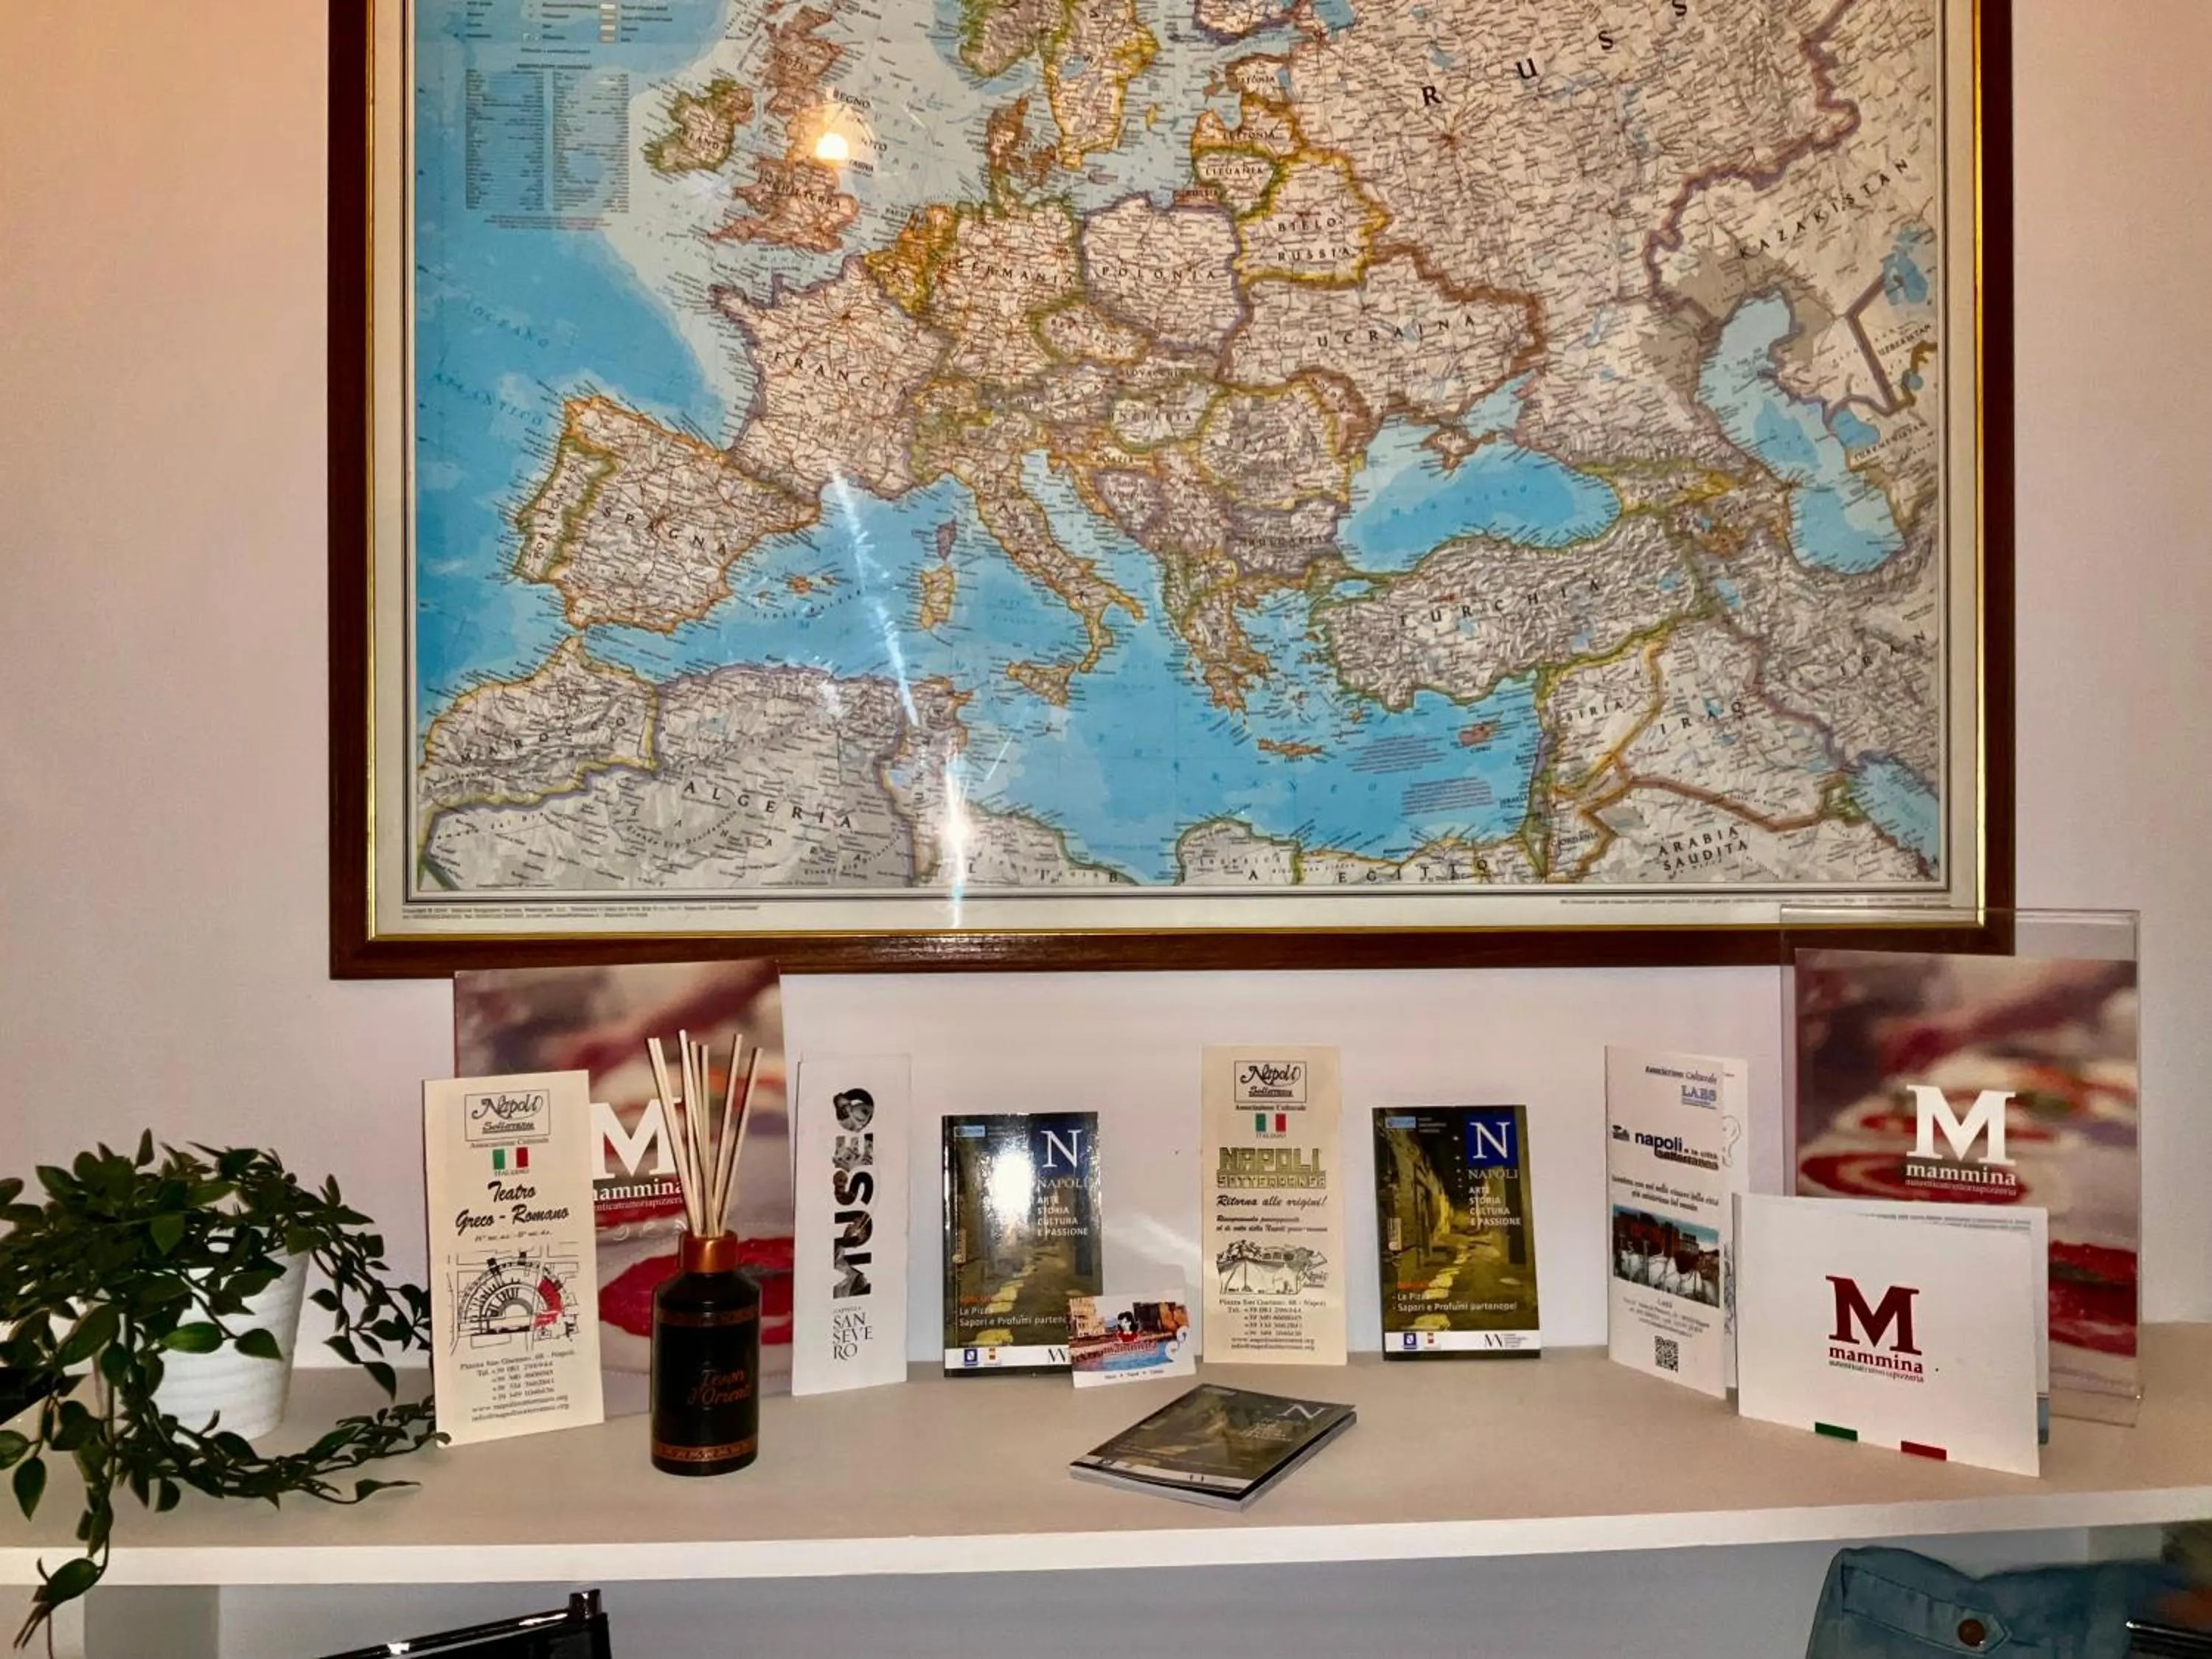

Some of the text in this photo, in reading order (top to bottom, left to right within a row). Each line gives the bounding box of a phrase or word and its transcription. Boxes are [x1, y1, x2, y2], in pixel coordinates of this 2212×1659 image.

[1205, 167, 1263, 175] LITUANIA
[1739, 159, 1909, 261] KAZAKISTAN
[1278, 247, 1353, 262] RUSSIA
[955, 258, 1074, 285] GERMANIA
[1102, 265, 1216, 281] POLONIA
[1317, 315, 1475, 348] UCRAINA
[774, 351, 909, 397] FRANCIA
[602, 506, 726, 556] SPAGNA
[1399, 578, 1600, 626] TURCHIA
[1566, 700, 1624, 721] SIRIA
[1660, 700, 1745, 736] IRAQ
[461, 717, 626, 764] MAROCCO
[684, 781, 852, 828] ALGERIA
[1659, 826, 1739, 858] ARABIA
[1663, 839, 1748, 872] SAUDITA
[1239, 1063, 1302, 1087] Napoli
[471, 1094, 543, 1119] Napoli
[1906, 1084, 2017, 1166] M
[590, 1098, 682, 1180] M
[1040, 1129, 1083, 1168] N
[1469, 1121, 1511, 1159] N
[1635, 1132, 1683, 1156] napoli
[1218, 1147, 1320, 1171] NAPOLI
[1468, 1169, 1519, 1180] NAPOLI
[1906, 1164, 2017, 1186] mammina
[487, 1180, 537, 1203] Teatro
[833, 1088, 875, 1299] MUSEO
[1262, 1195, 1283, 1206] alle
[1286, 1194, 1328, 1211] origini!
[1469, 1196, 1501, 1205] STORIA
[456, 1209, 495, 1236] Greco
[511, 1204, 569, 1225] Romano
[1037, 1206, 1070, 1215] STORIA
[1037, 1217, 1079, 1227] CULTURA
[1470, 1206, 1511, 1216] CULTURA
[1478, 1217, 1522, 1226] PASSIONE
[1046, 1228, 1089, 1237] PASSIONE
[1397, 1301, 1425, 1312] Sapori
[1434, 1301, 1468, 1311] Profumi
[1470, 1301, 1517, 1312] partenopei
[1825, 1275, 1922, 1356] M
[834, 1312, 866, 1329] SAN
[960, 1318, 987, 1328] Sapori
[998, 1315, 1032, 1326] Profumi
[1035, 1314, 1066, 1325] parten
[833, 1326, 873, 1343] SEVE
[834, 1342, 858, 1361] RO
[1829, 1346, 1923, 1374] mammina
